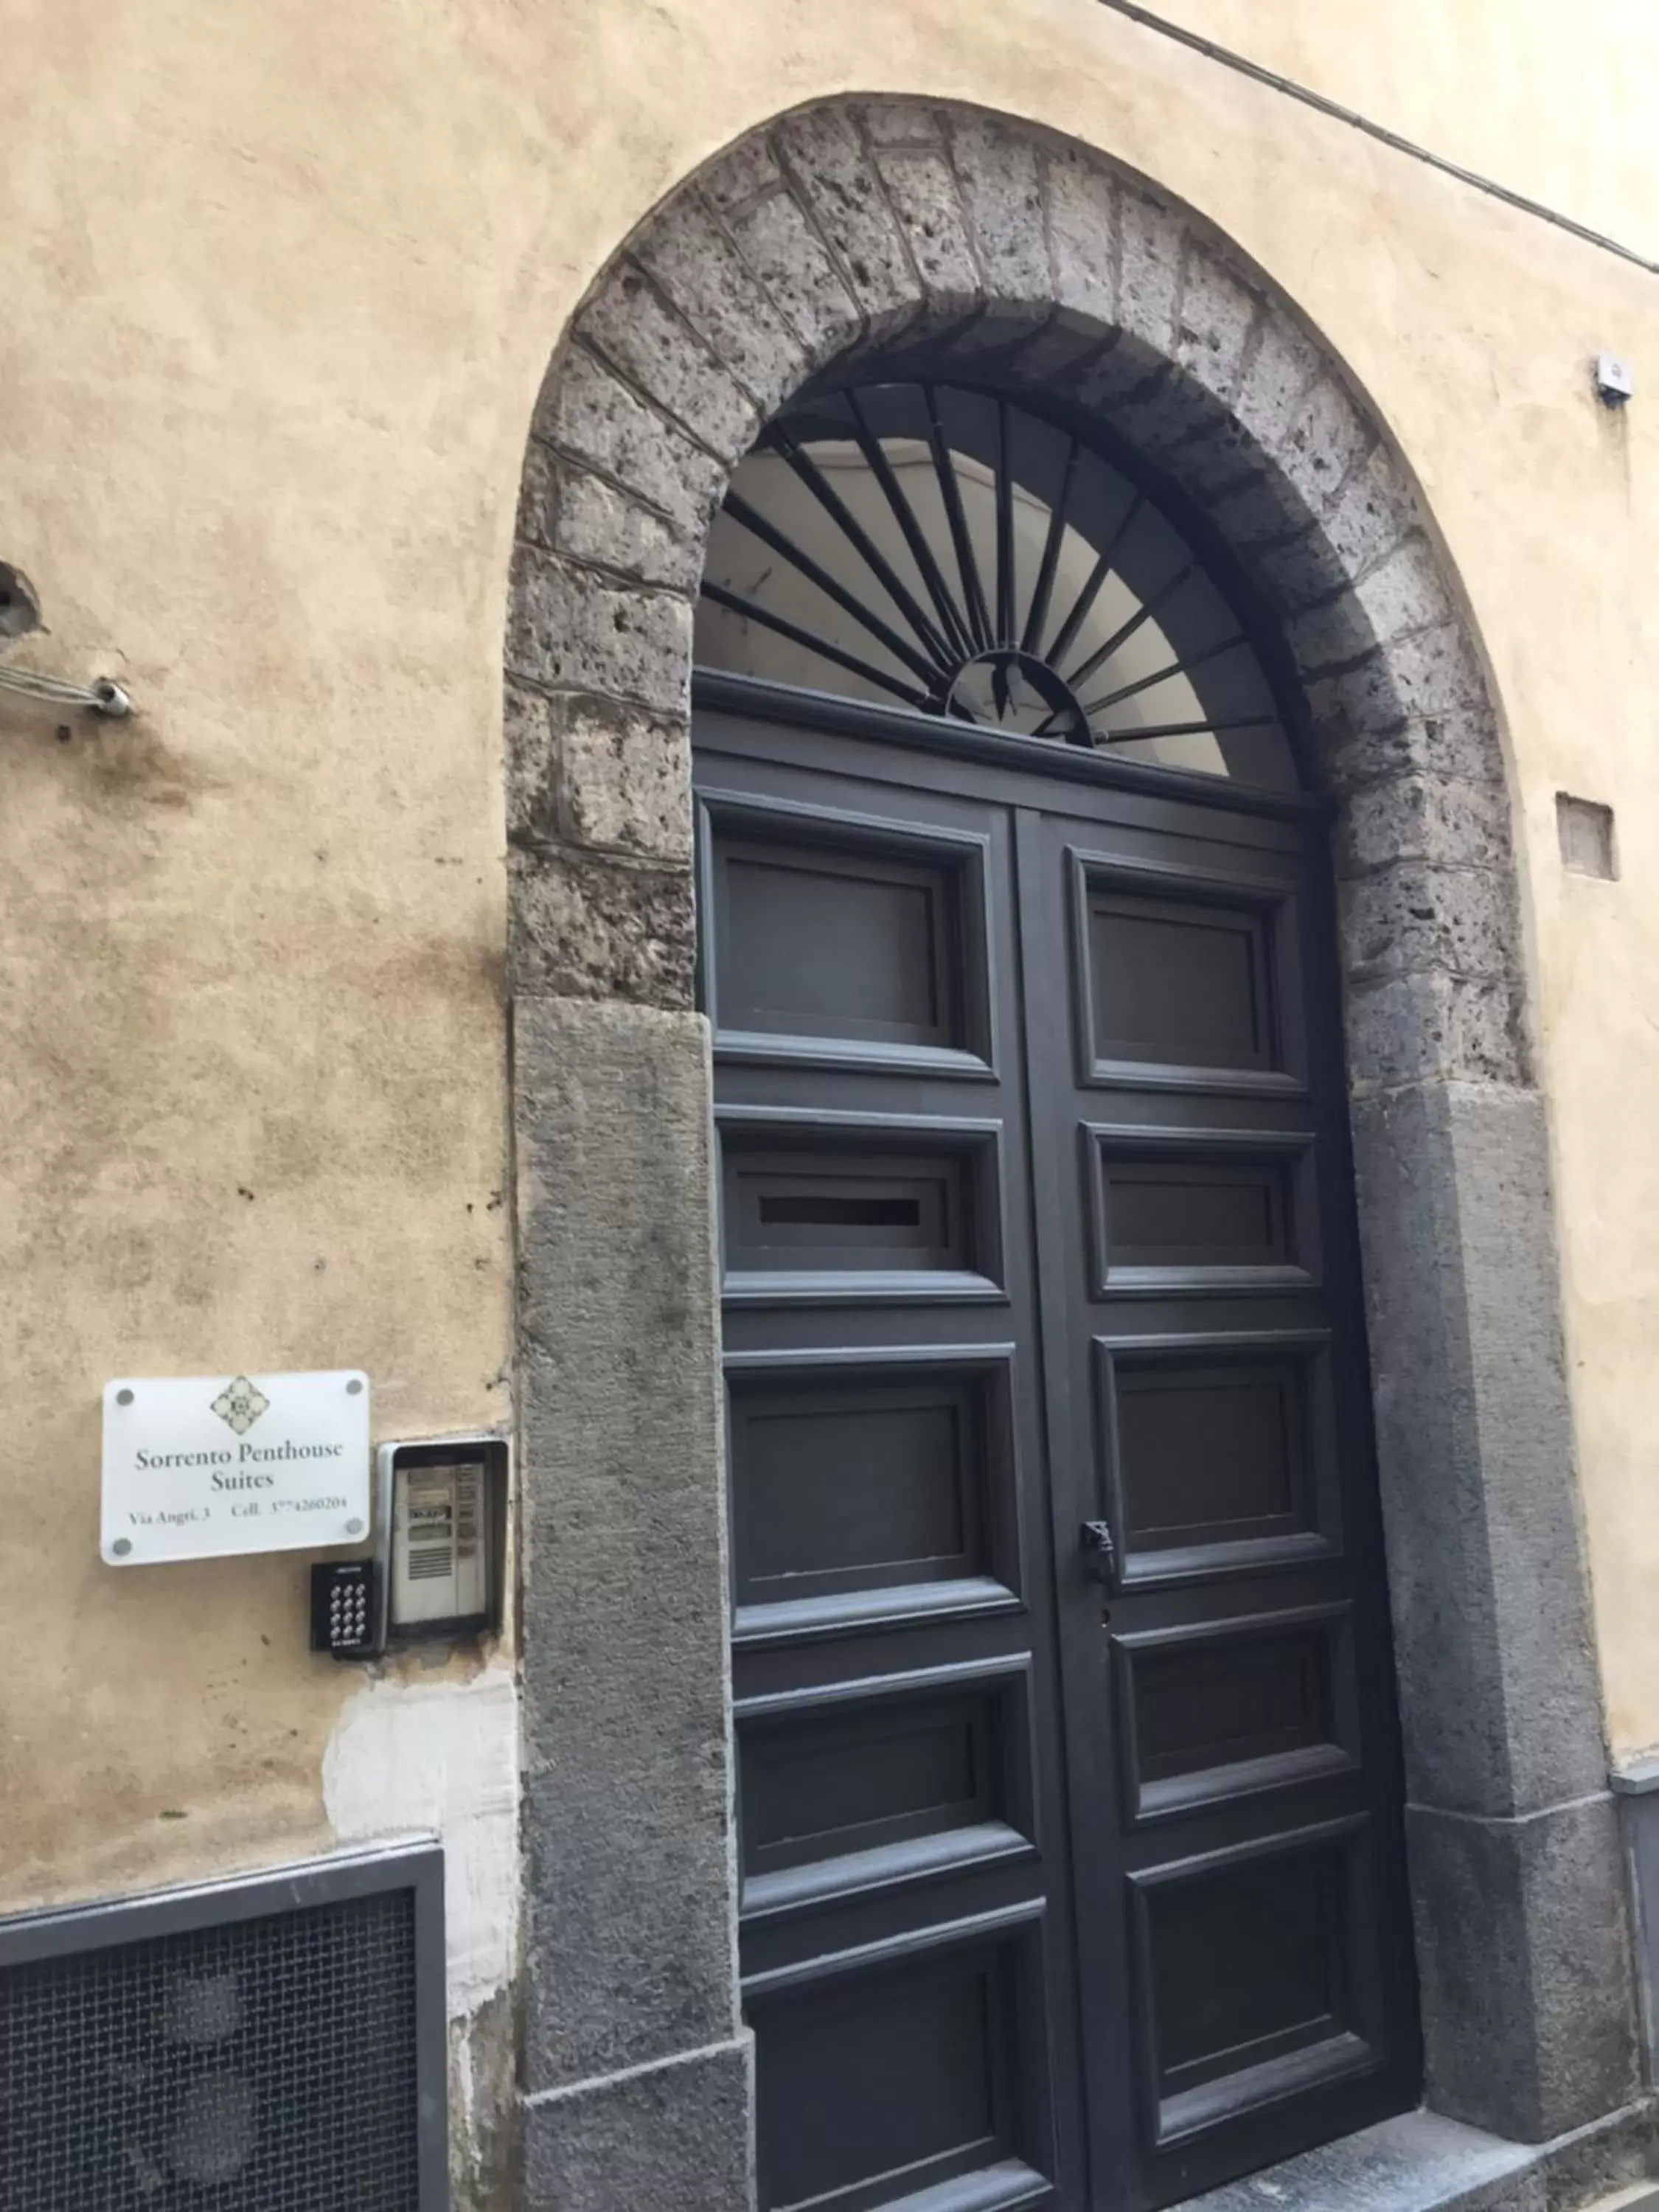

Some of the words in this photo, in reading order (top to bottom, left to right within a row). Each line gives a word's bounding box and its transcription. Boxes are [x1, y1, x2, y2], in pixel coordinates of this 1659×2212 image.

[134, 1447, 232, 1471] Sorrento
[237, 1439, 344, 1464] Penthouse
[210, 1470, 275, 1492] Suites
[128, 1512, 153, 1526] Via
[230, 1501, 261, 1517] Cell.
